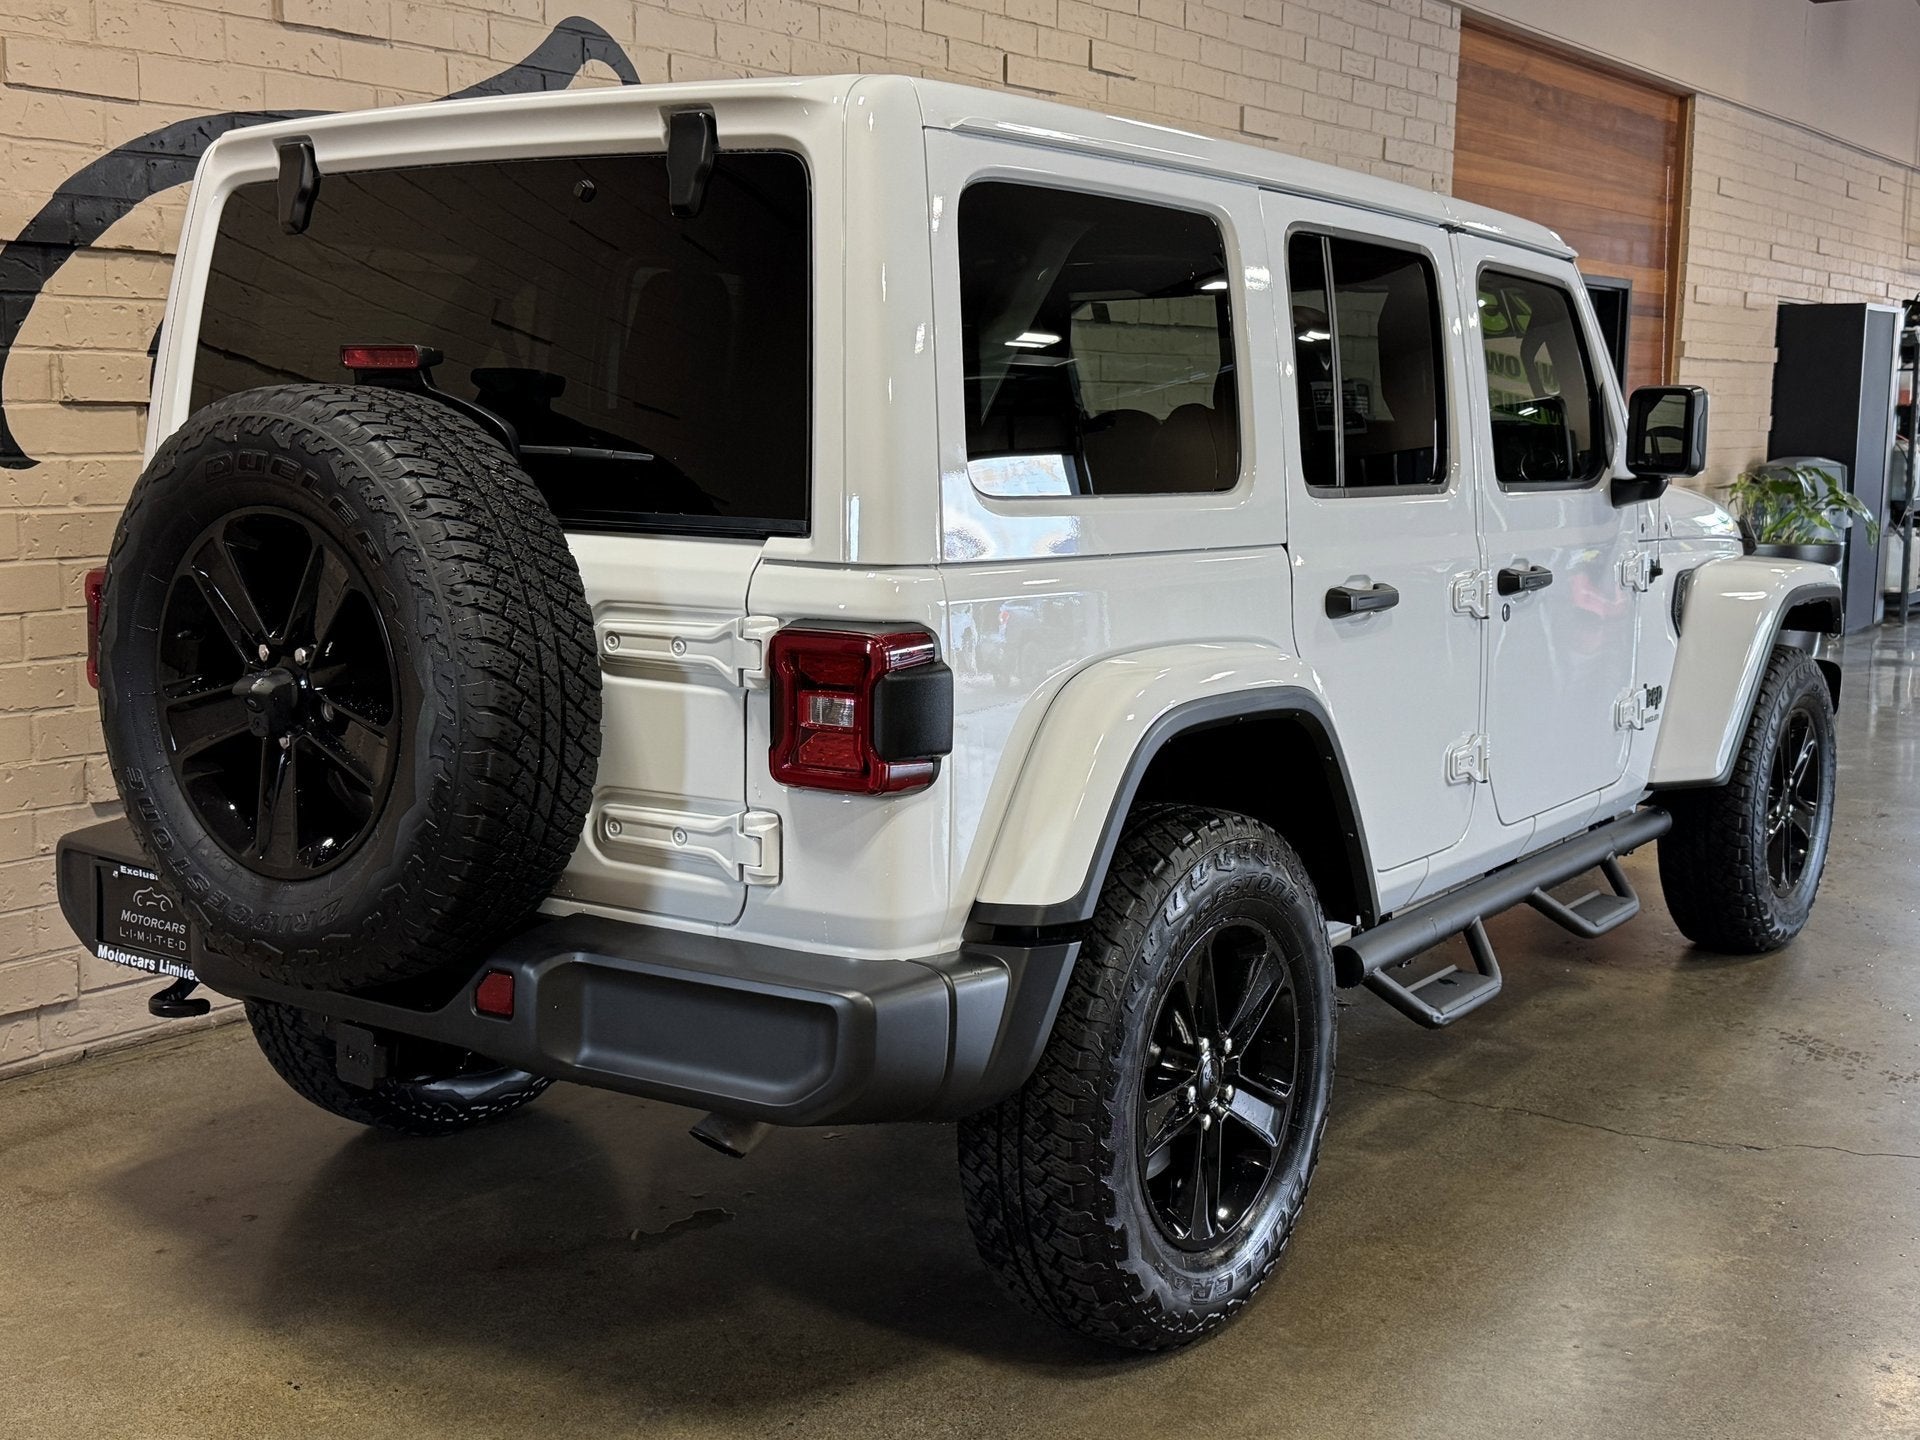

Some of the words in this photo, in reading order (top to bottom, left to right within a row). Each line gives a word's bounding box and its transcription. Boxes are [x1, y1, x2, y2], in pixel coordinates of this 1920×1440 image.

[204, 450, 384, 567] DUELER
[124, 764, 344, 934] BRIDGESTONE
[97, 944, 156, 971] Motorcars
